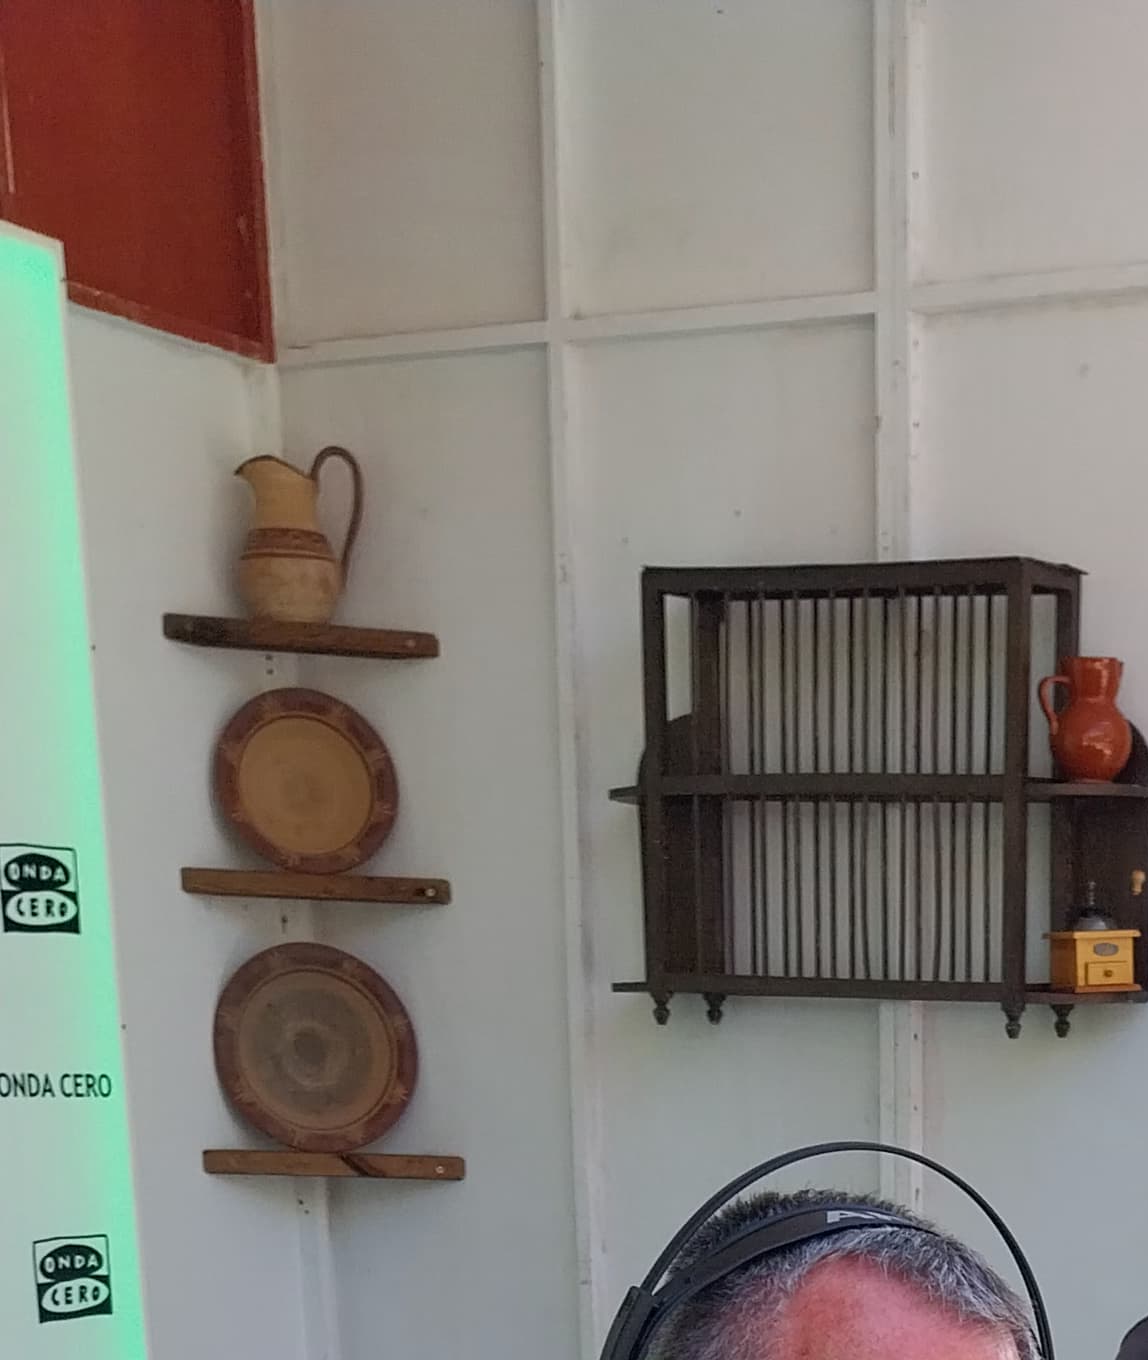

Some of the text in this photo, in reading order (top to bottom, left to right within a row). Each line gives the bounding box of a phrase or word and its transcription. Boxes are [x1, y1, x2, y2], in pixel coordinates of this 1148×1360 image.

[8, 863, 66, 883] ONDA
[16, 898, 69, 918] CERO
[0, 1072, 112, 1099] ONDA CERO
[44, 1253, 99, 1273] ONDA
[50, 1285, 102, 1305] CERO
